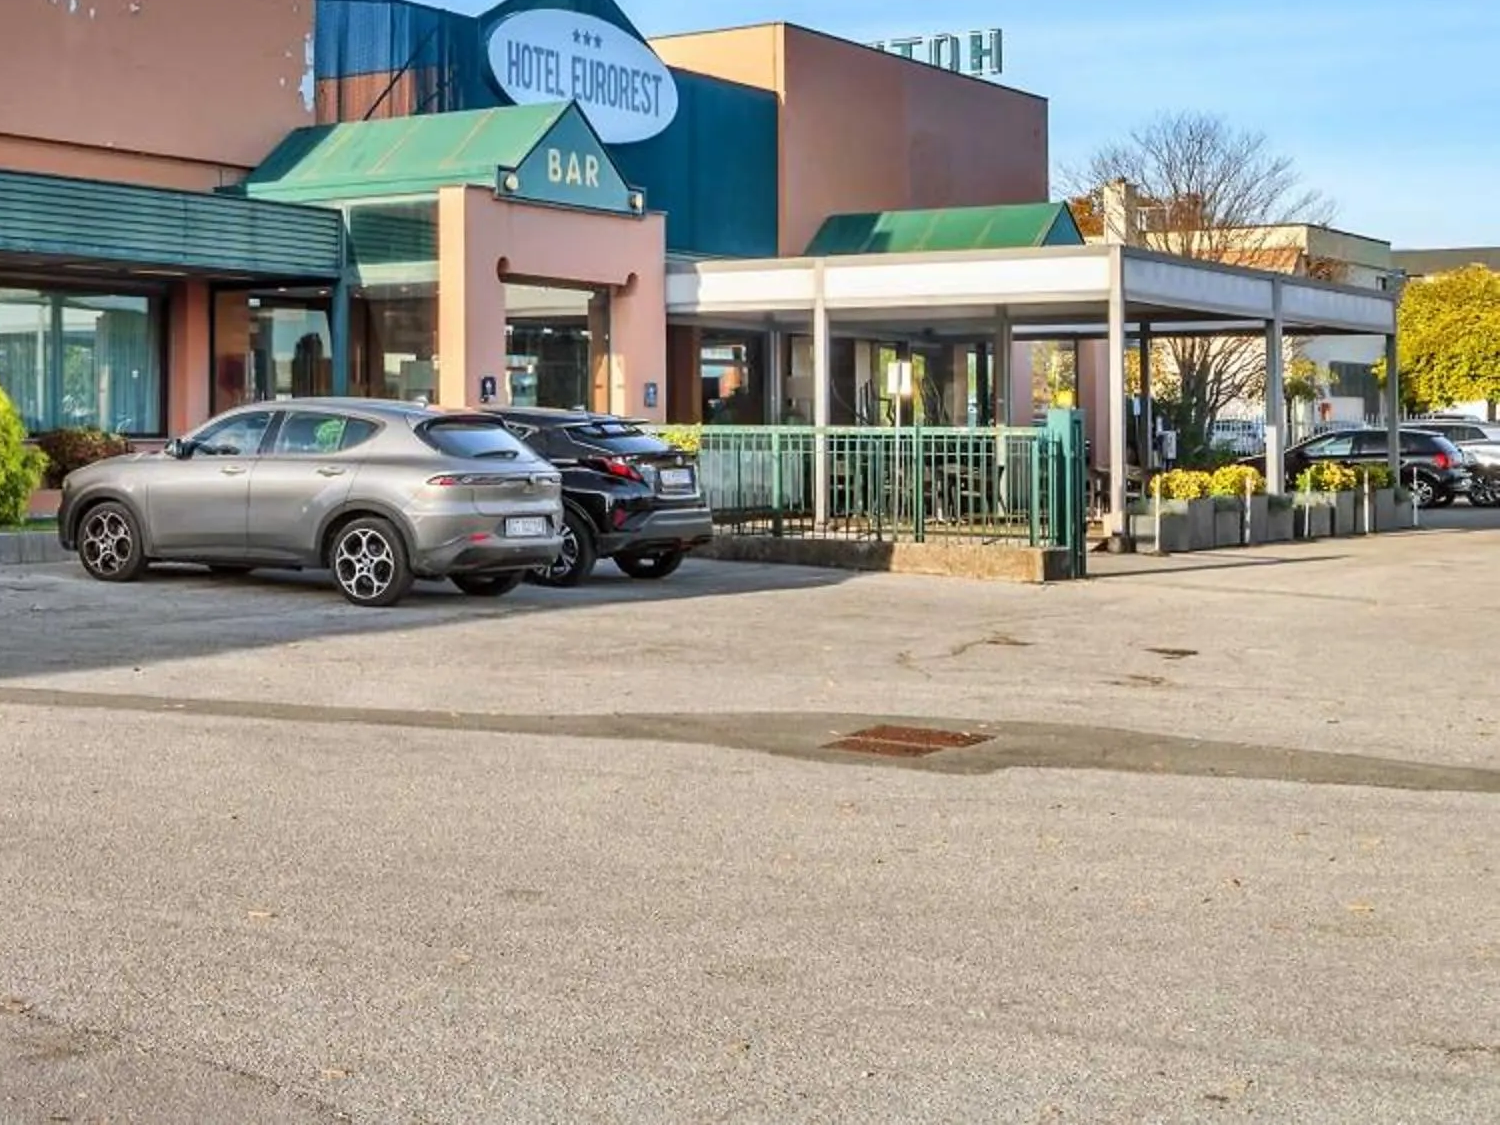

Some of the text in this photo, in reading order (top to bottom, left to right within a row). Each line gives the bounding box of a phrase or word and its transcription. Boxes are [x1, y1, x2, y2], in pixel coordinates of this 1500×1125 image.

[506, 40, 663, 118] HOTEL EUROREST
[547, 148, 600, 188] BAR
